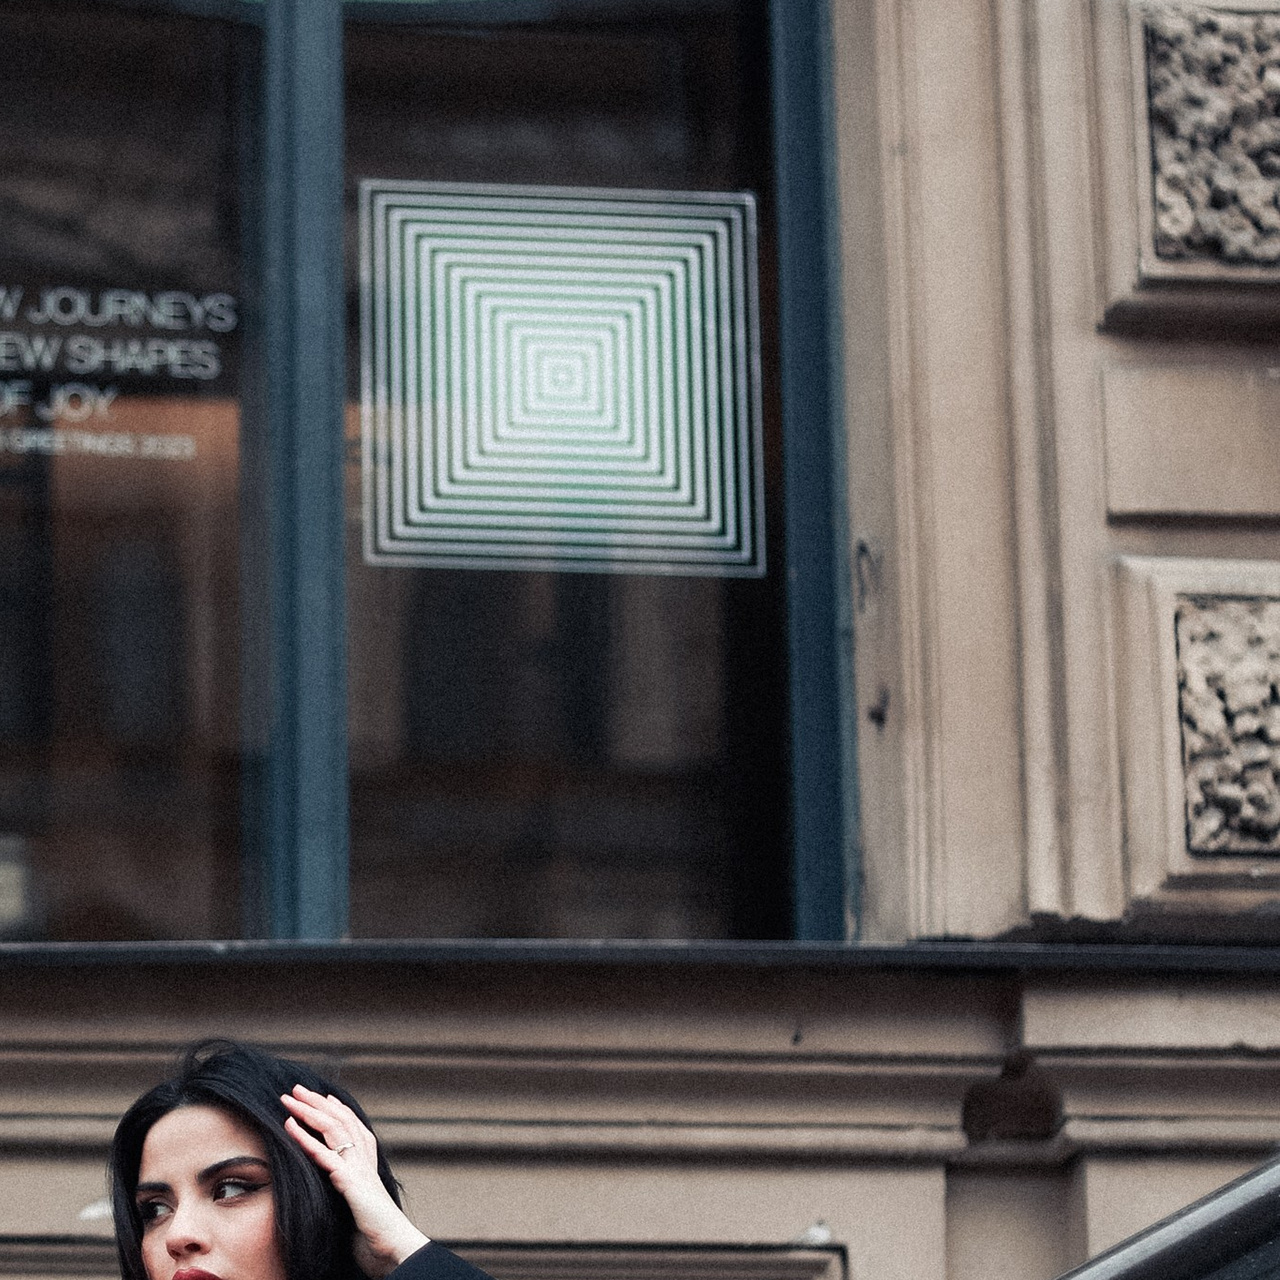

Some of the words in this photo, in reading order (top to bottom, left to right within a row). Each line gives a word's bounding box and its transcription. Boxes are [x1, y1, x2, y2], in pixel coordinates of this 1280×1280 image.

[26, 285, 238, 332] JOURNEYS
[67, 334, 220, 380] SHAPES
[36, 382, 118, 422] JOY
